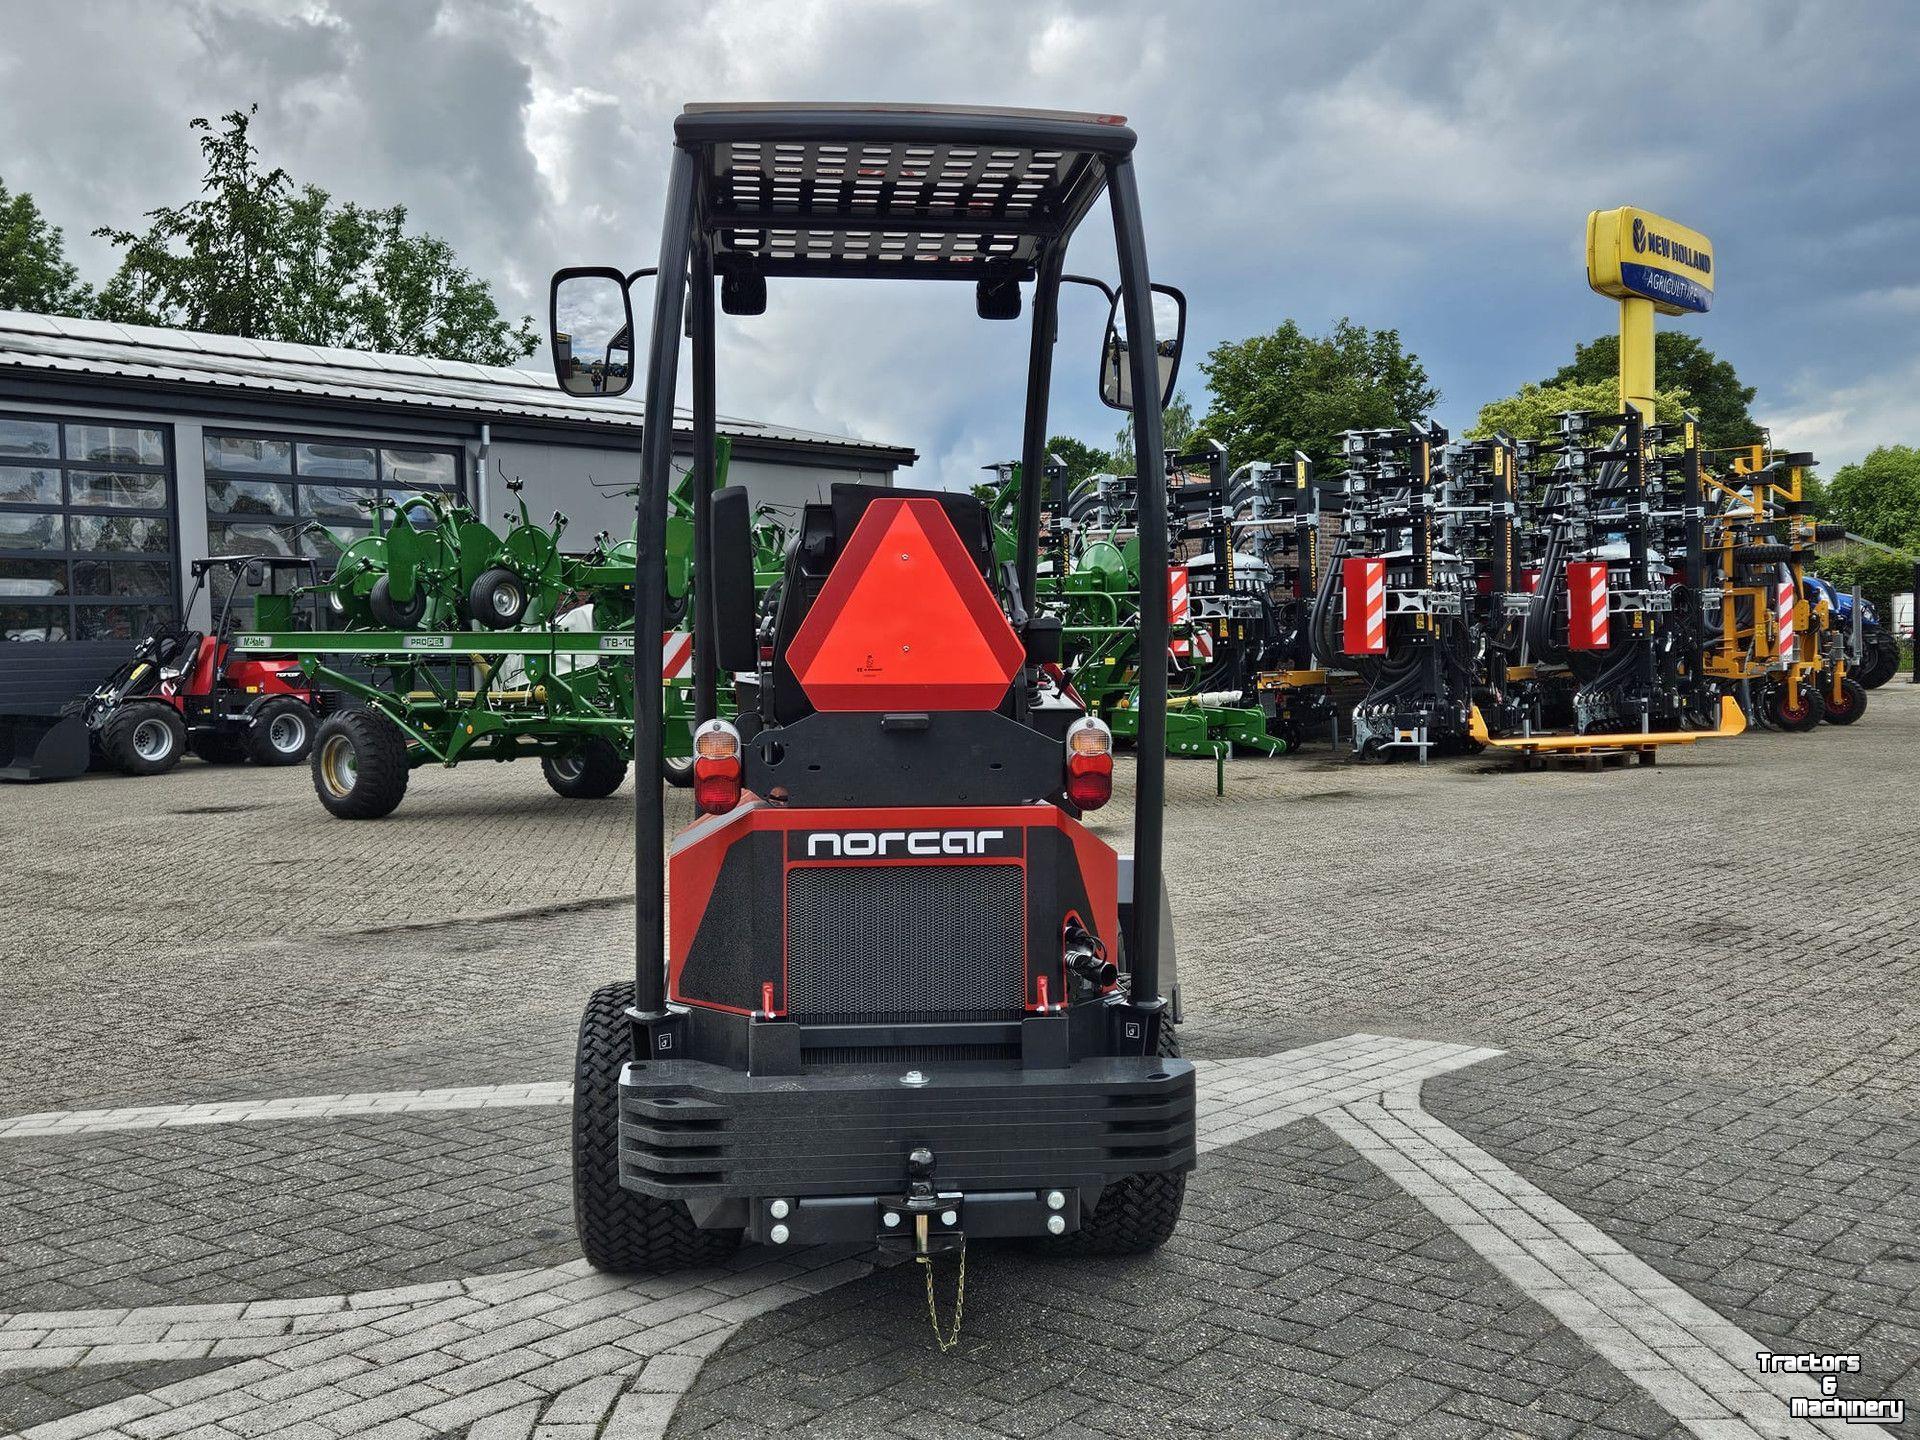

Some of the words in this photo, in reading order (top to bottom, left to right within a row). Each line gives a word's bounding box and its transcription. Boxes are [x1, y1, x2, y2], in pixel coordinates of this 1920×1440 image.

[1647, 232, 1670, 258] NEW
[1671, 241, 1711, 274] HOLLAND
[1647, 272, 1698, 302] AGRICULTURE
[604, 637, 635, 648] T8-10
[807, 830, 1004, 856] norcar
